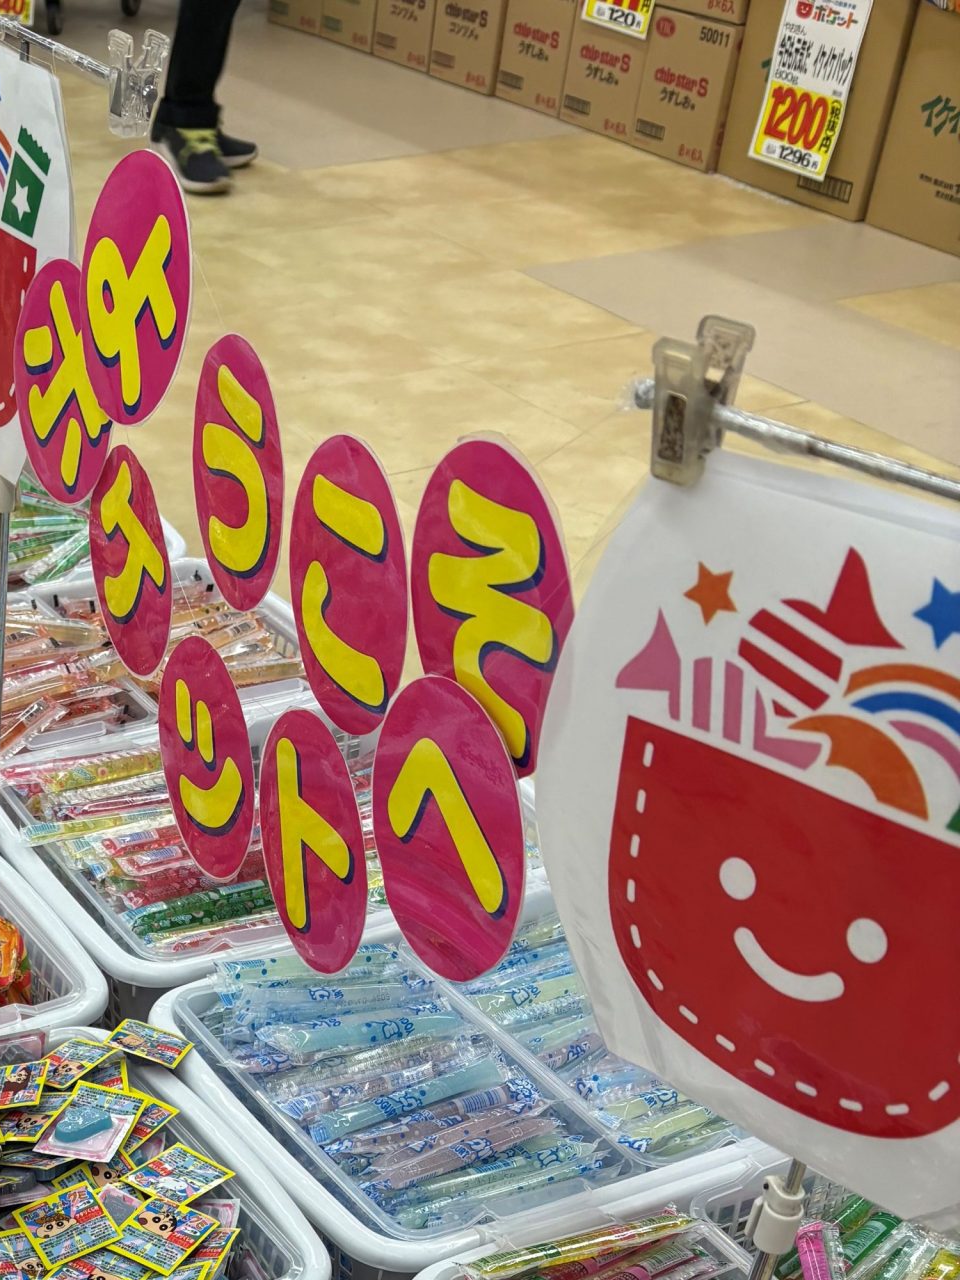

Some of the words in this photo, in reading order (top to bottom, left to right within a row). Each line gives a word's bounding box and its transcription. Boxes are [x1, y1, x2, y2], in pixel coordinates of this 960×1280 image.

[608, 7, 635, 26] 120
[813, 4, 858, 29] ポケット
[699, 25, 730, 48] 50011
[763, 85, 829, 150] 1200
[779, 144, 810, 168] 1296
